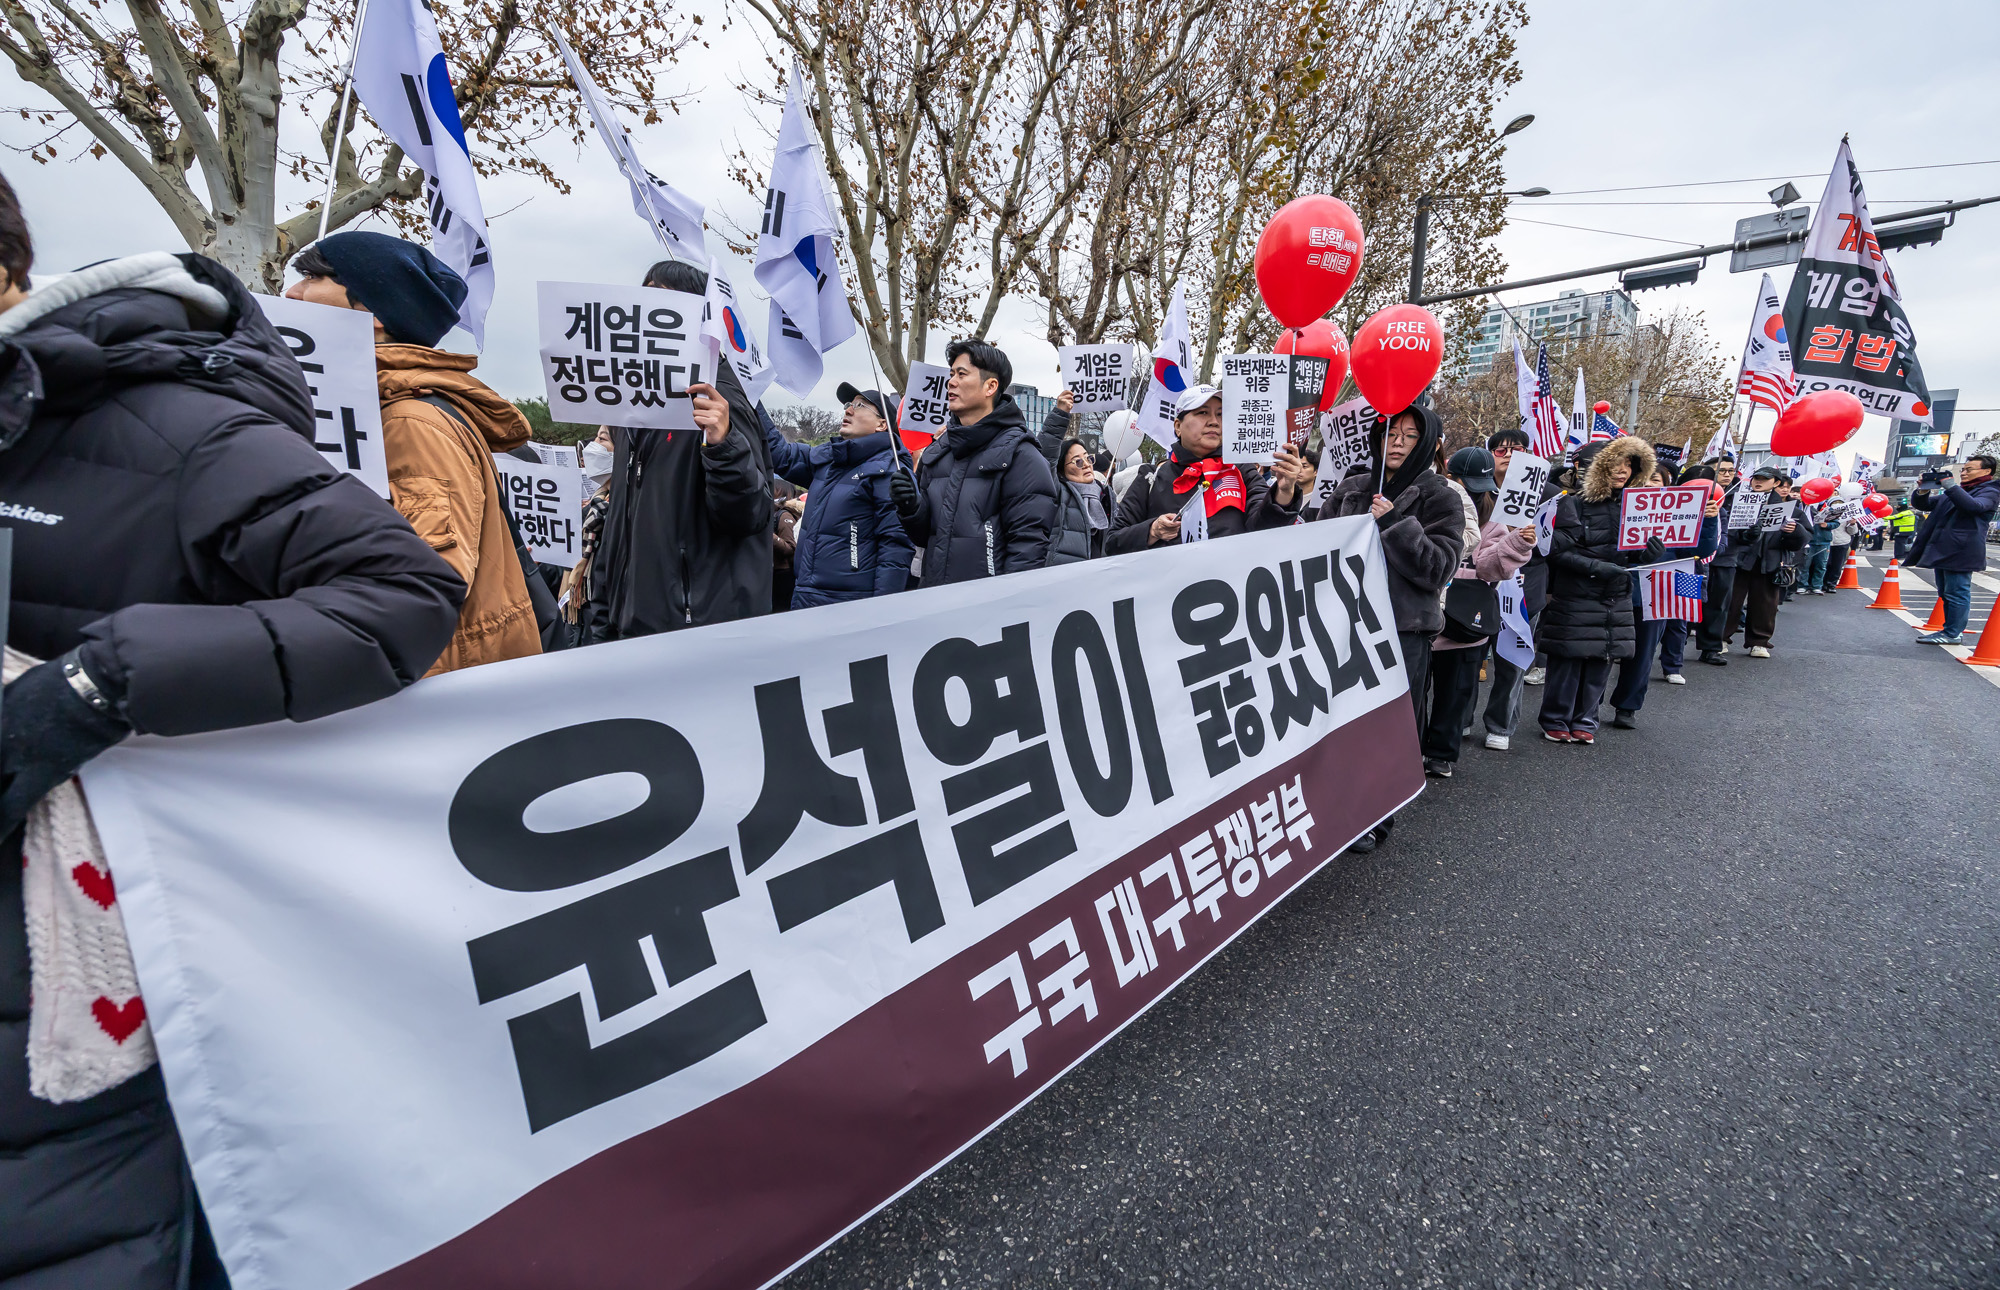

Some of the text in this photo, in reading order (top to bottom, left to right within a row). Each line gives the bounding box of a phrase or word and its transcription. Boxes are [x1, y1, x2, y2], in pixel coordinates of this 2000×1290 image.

[1309, 226, 1345, 251] 탄핵
[1320, 251, 1351, 275] 내란
[565, 302, 686, 356] 계엄은
[1386, 321, 1426, 335] FREE
[1378, 336, 1431, 352] YOON
[1075, 352, 1122, 377] 계엄은
[1224, 359, 1288, 376] 헌법재판소
[1295, 360, 1313, 377] 계엄
[550, 355, 706, 408] 정당했다
[1068, 378, 1127, 403] 정당했다
[1245, 376, 1270, 392] 위증
[1294, 376, 1312, 394] 녹취
[908, 397, 951, 425] 정당
[1241, 399, 1273, 412] 곽종근:
[1237, 413, 1275, 426] 국회의원
[1328, 405, 1378, 442] 계엄은
[1237, 427, 1275, 440] 끌어내라
[1329, 434, 1372, 470] 정당했
[0, 501, 58, 525] ckies
[1503, 489, 1540, 519] 정당
[1634, 492, 1694, 511] STOP
[1648, 512, 1673, 524] THE
[1626, 525, 1691, 544] STEAL
[448, 549, 1398, 1135] 윤석열이 옳았다!
[967, 773, 1316, 1079] 구국 대구투쟁본부
